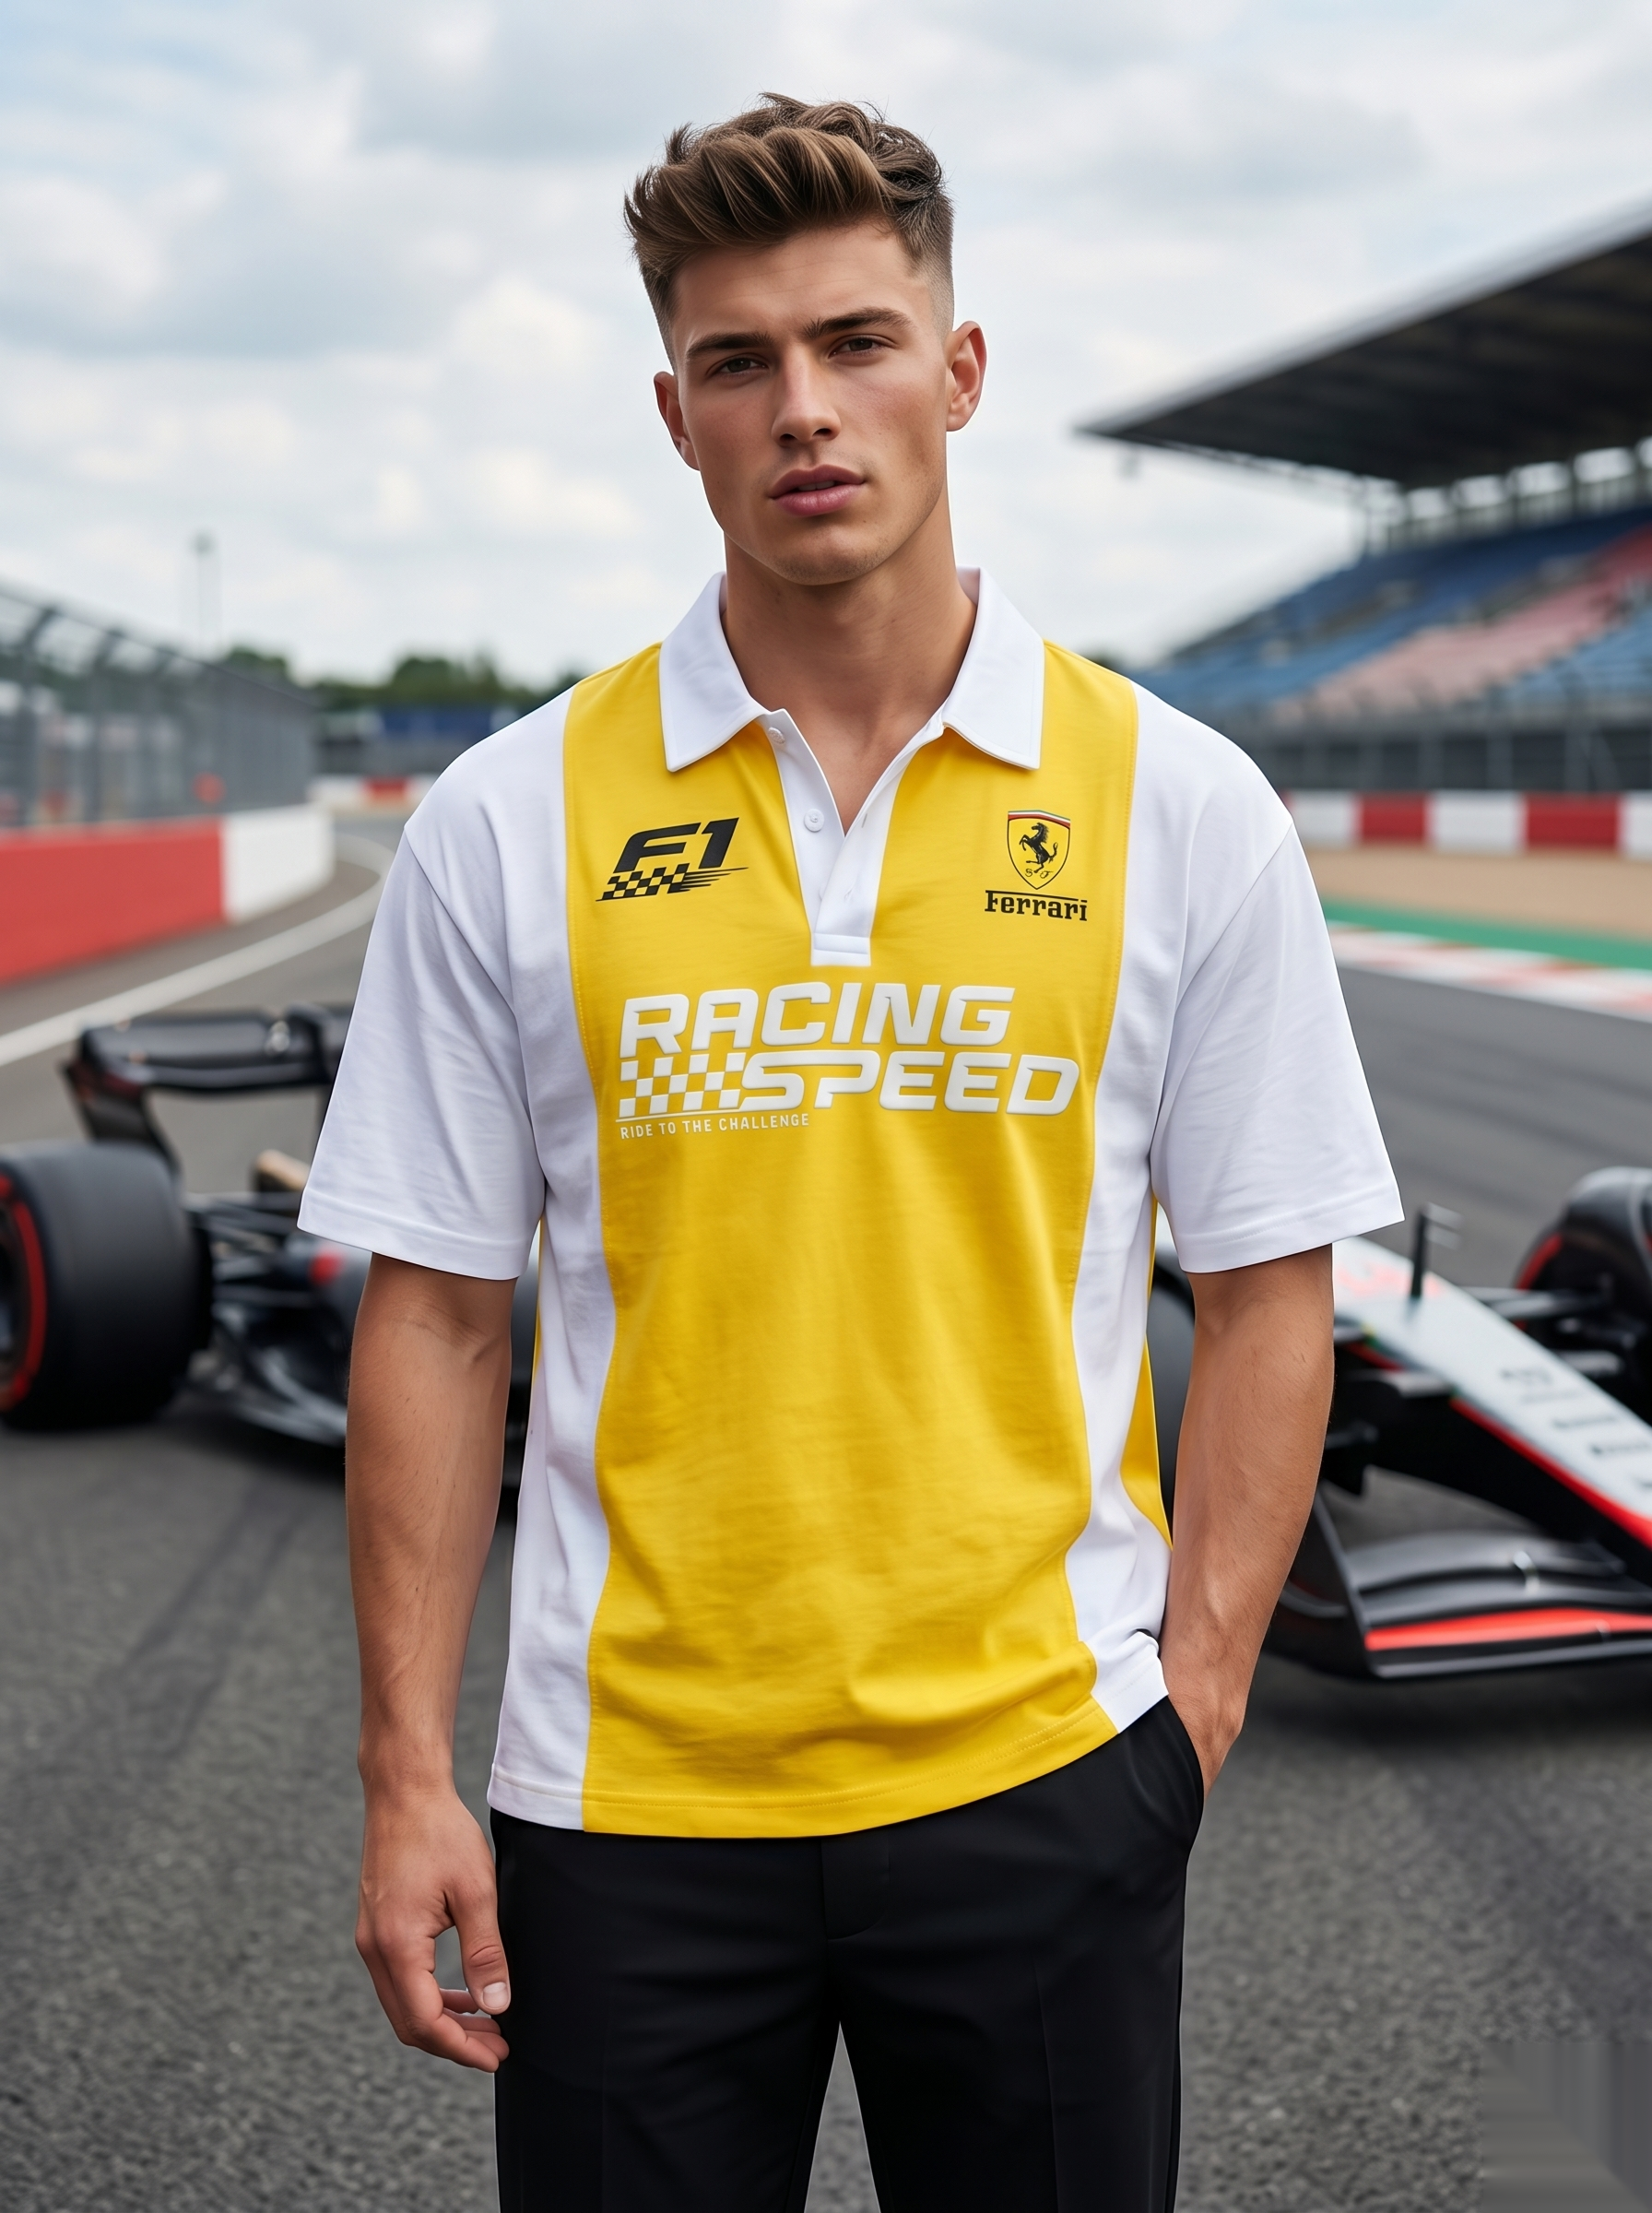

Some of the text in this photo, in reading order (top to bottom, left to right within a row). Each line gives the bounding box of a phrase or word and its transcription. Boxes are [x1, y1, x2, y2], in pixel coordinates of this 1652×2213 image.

[613, 817, 739, 873] F1
[985, 889, 1088, 922] Ferrari
[620, 981, 1015, 1059] RACING
[738, 1049, 1080, 1117] SPEED
[620, 1113, 809, 1140] RIDE TO THE CHALLENGE
